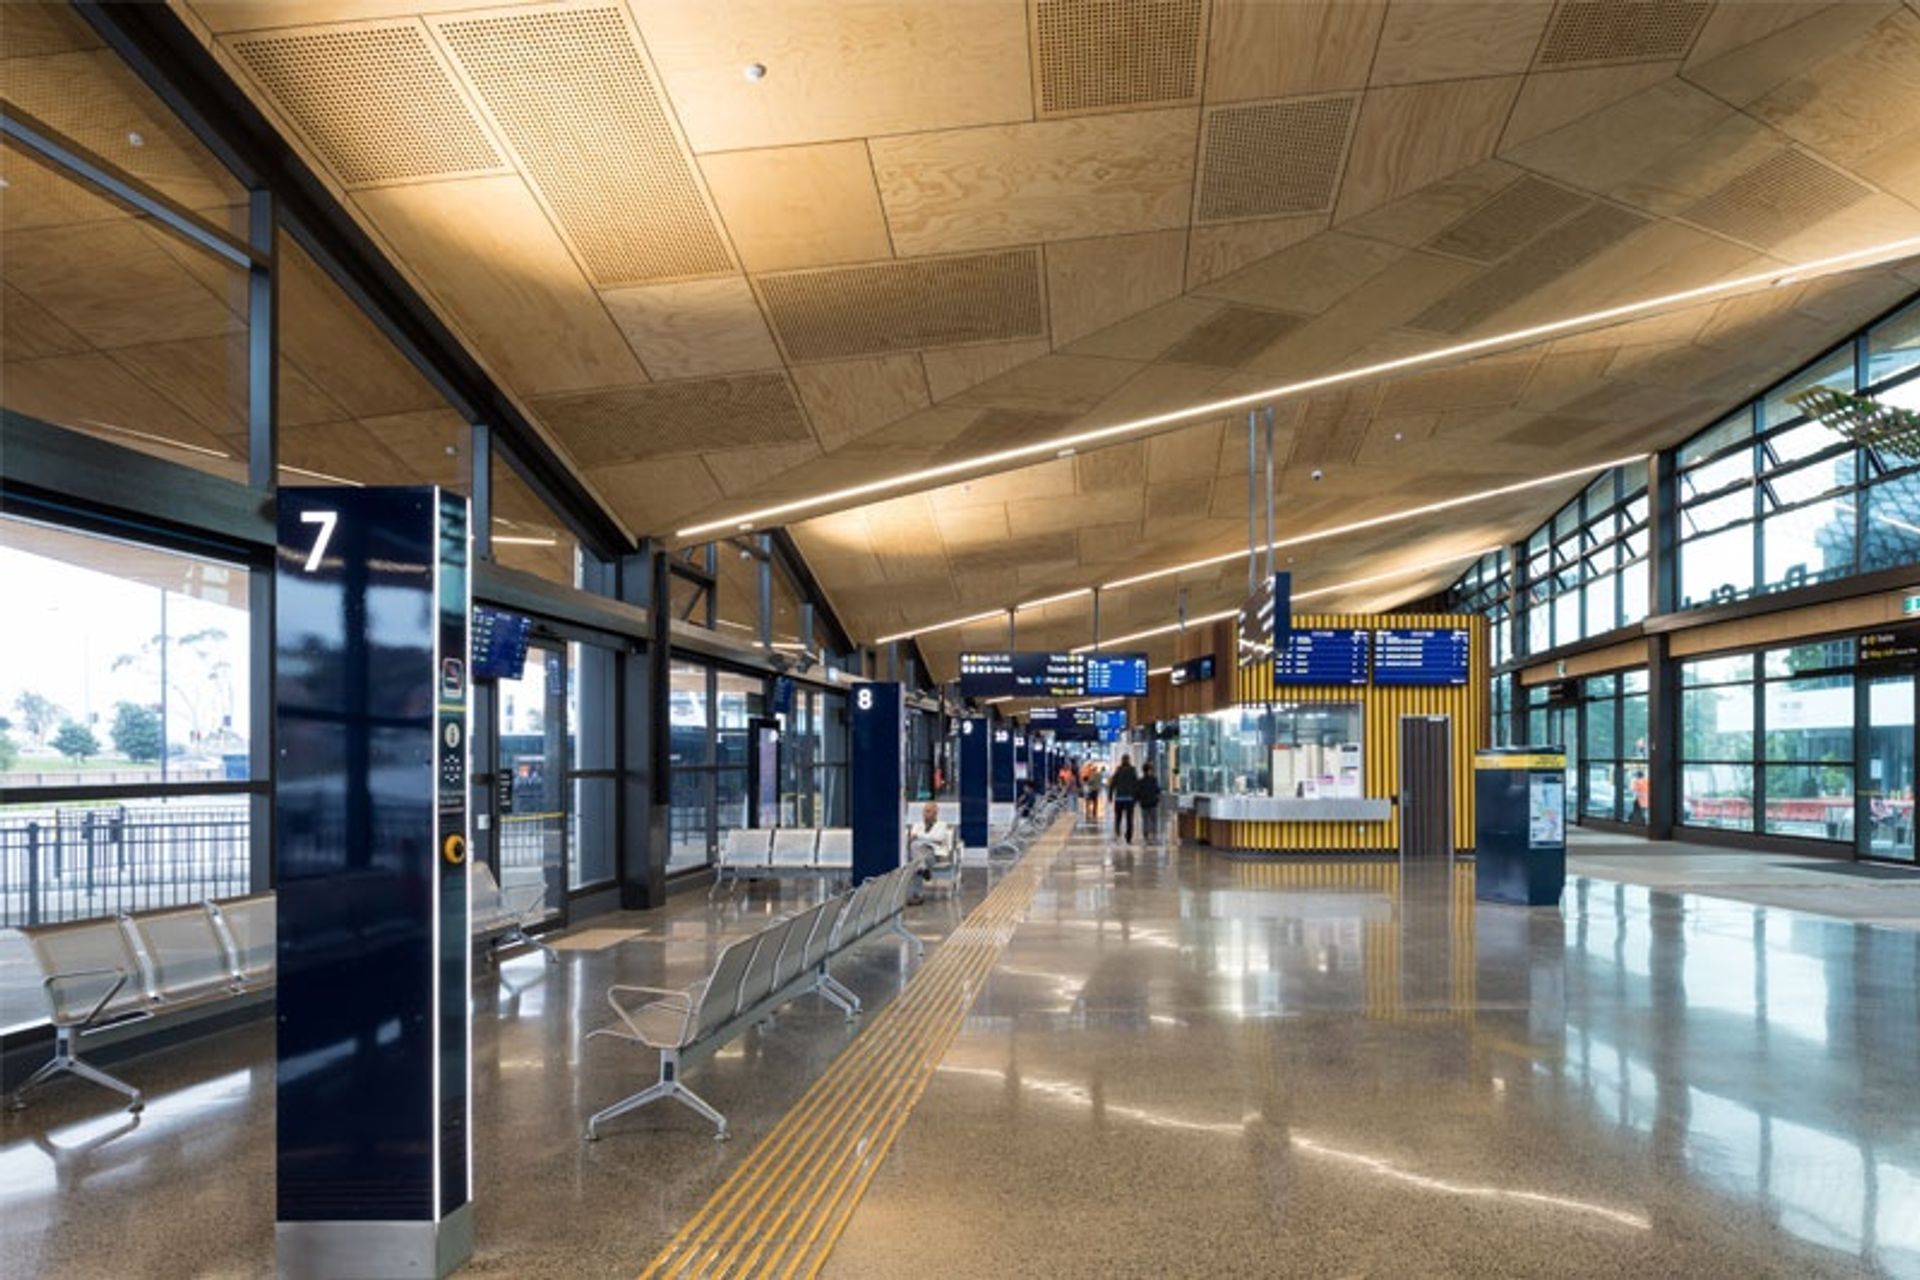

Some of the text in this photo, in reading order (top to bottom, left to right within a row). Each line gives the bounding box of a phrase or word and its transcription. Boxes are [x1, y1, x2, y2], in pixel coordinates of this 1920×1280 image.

[300, 511, 338, 572] 7
[858, 688, 872, 709] 8
[962, 720, 973, 734] 9
[995, 730, 1008, 742] 10
